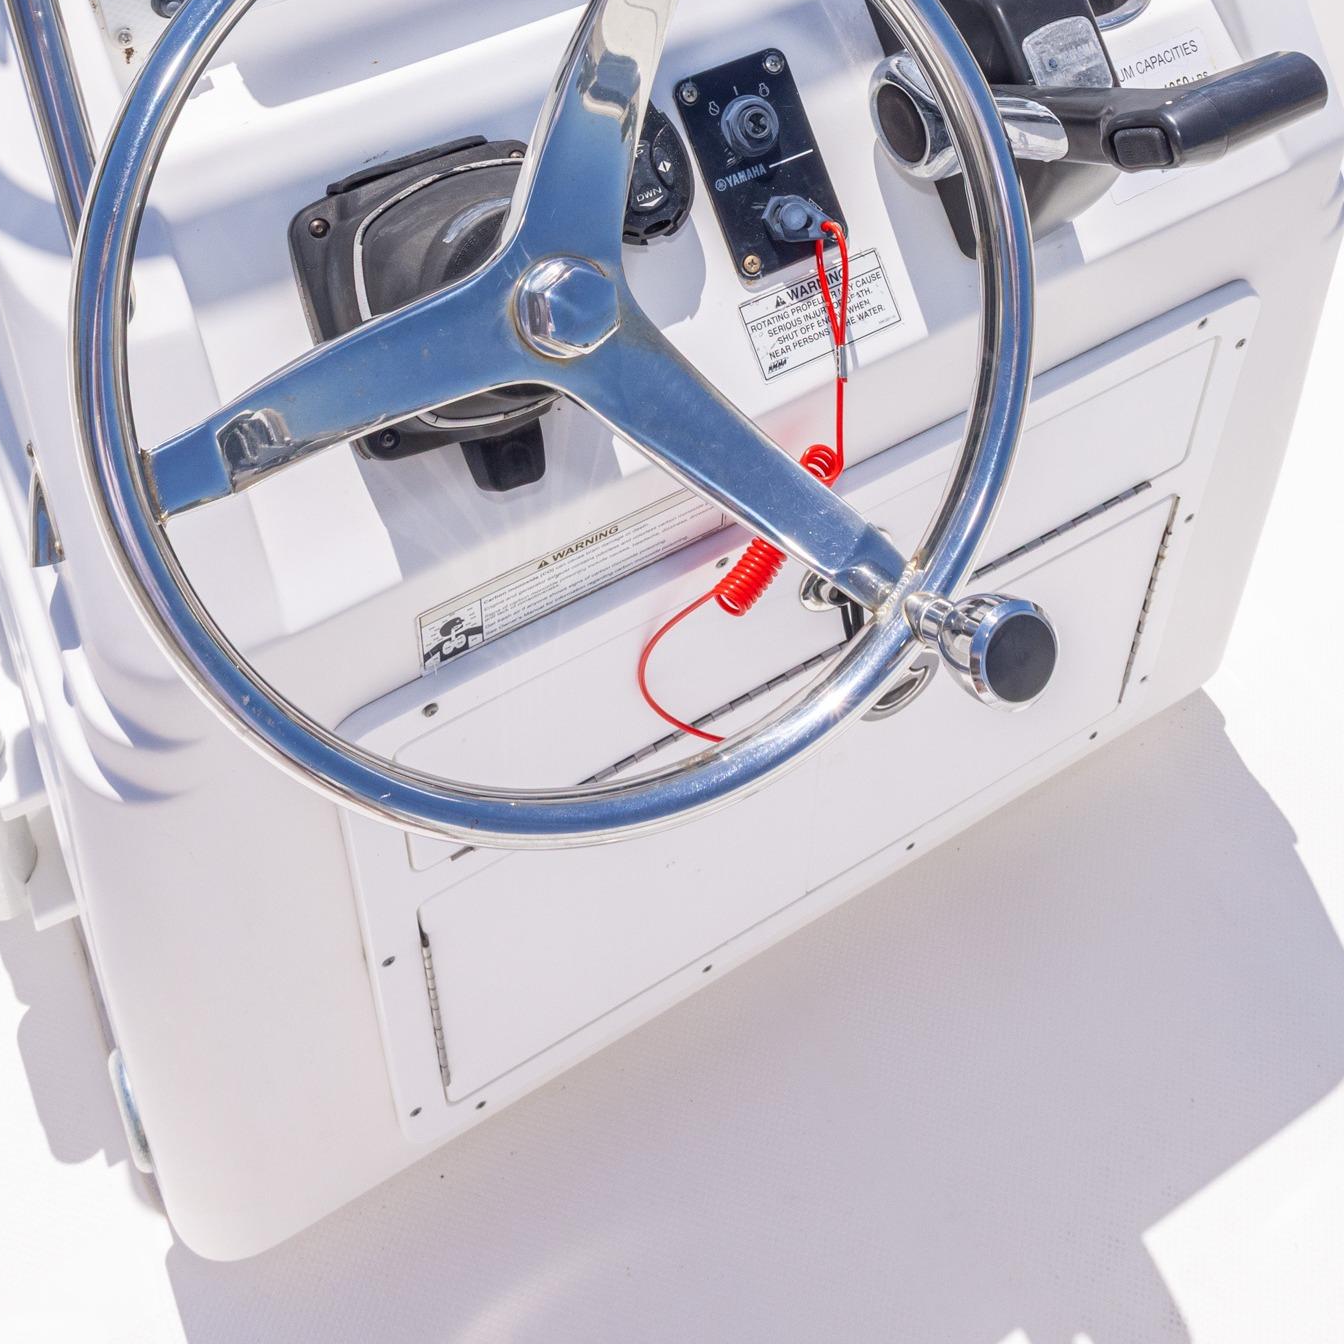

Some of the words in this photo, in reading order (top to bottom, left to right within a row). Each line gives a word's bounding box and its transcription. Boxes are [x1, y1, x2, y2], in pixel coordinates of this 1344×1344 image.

[1135, 39, 1199, 75] CAPACITIES
[726, 163, 767, 188] YAMAHA
[636, 187, 663, 203] DWN
[750, 312, 790, 333] ROTATING
[791, 289, 837, 317] PROPELLR
[855, 271, 882, 289] CAUSE
[767, 318, 803, 338] SERIOUS
[803, 306, 829, 322] INJUR
[768, 343, 792, 361] NEAR
[792, 329, 831, 351] PERSONS
[845, 315, 857, 328] HE
[857, 304, 886, 322] WATER.
[777, 330, 799, 345] SHUT
[799, 323, 816, 336] OFF
[847, 299, 871, 314] WHEN
[552, 525, 619, 562] WARNING
